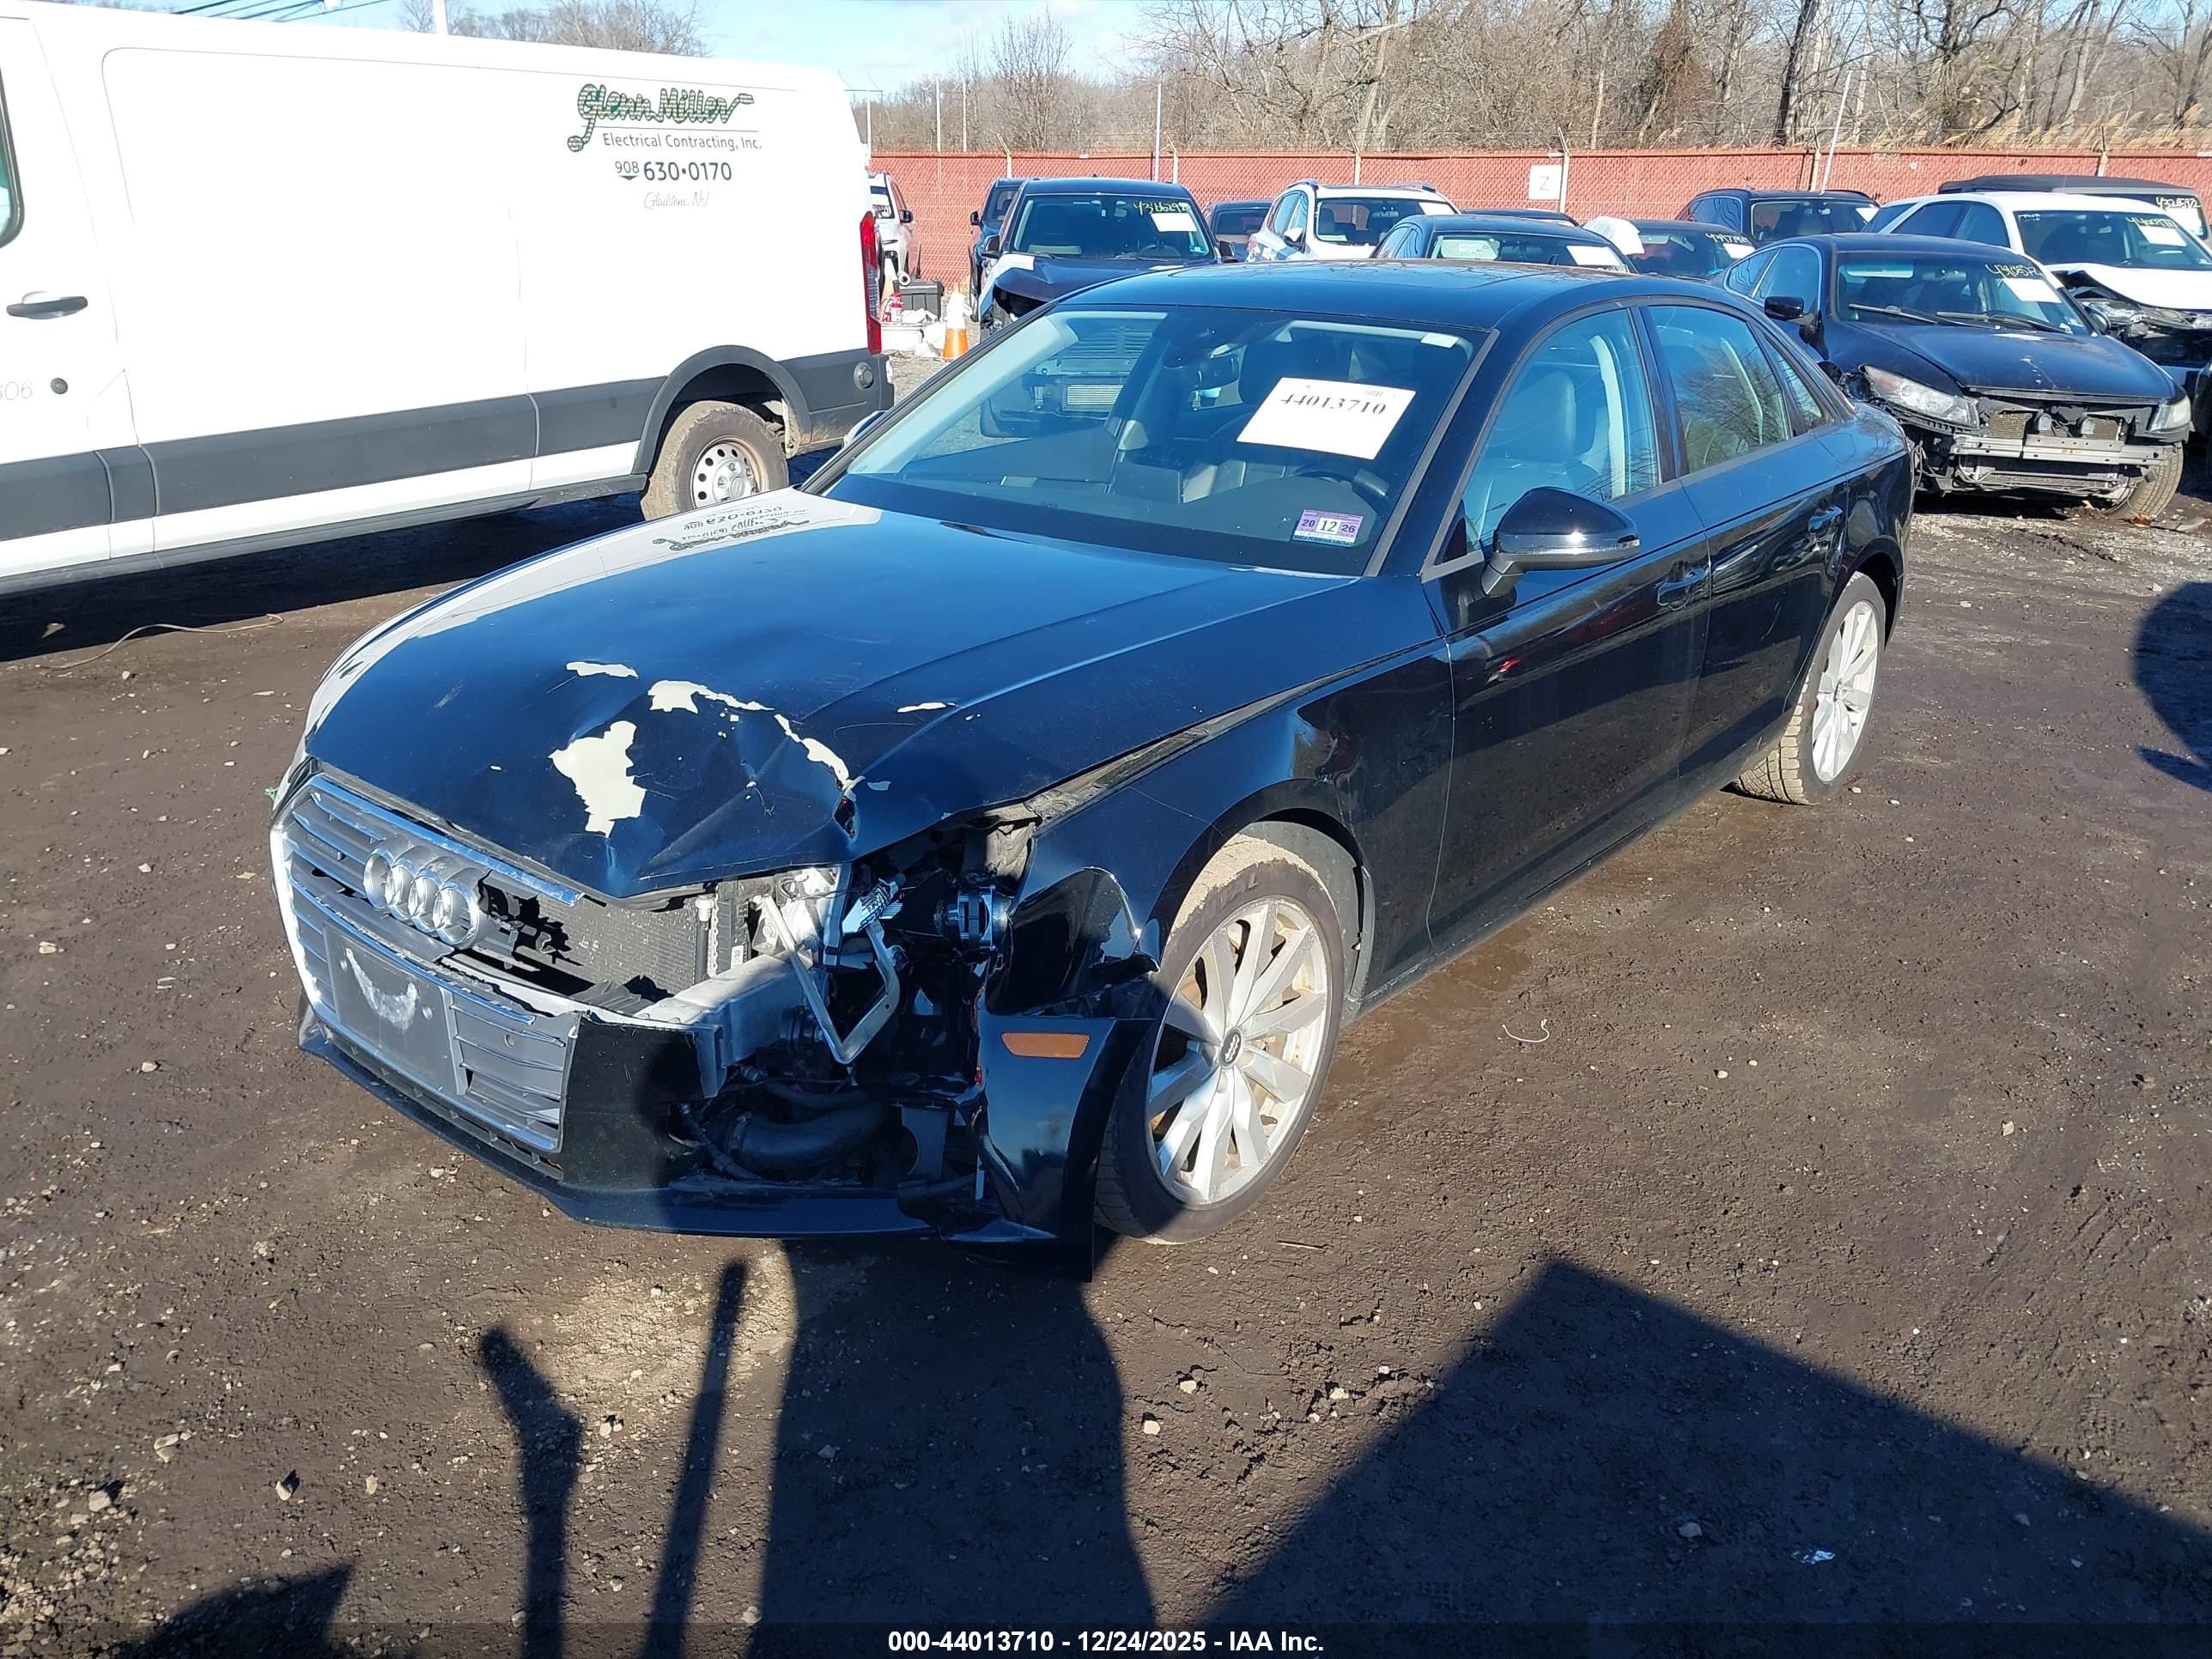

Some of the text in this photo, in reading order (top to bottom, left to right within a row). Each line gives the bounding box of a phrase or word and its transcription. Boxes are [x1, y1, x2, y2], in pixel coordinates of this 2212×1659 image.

[568, 83, 754, 152] Glenn Miller
[603, 132, 763, 152] Electrical Contracting, Inc.
[615, 161, 639, 173] 908
[1280, 393, 1386, 415] 44013710
[1301, 519, 1356, 533] 20 12 26
